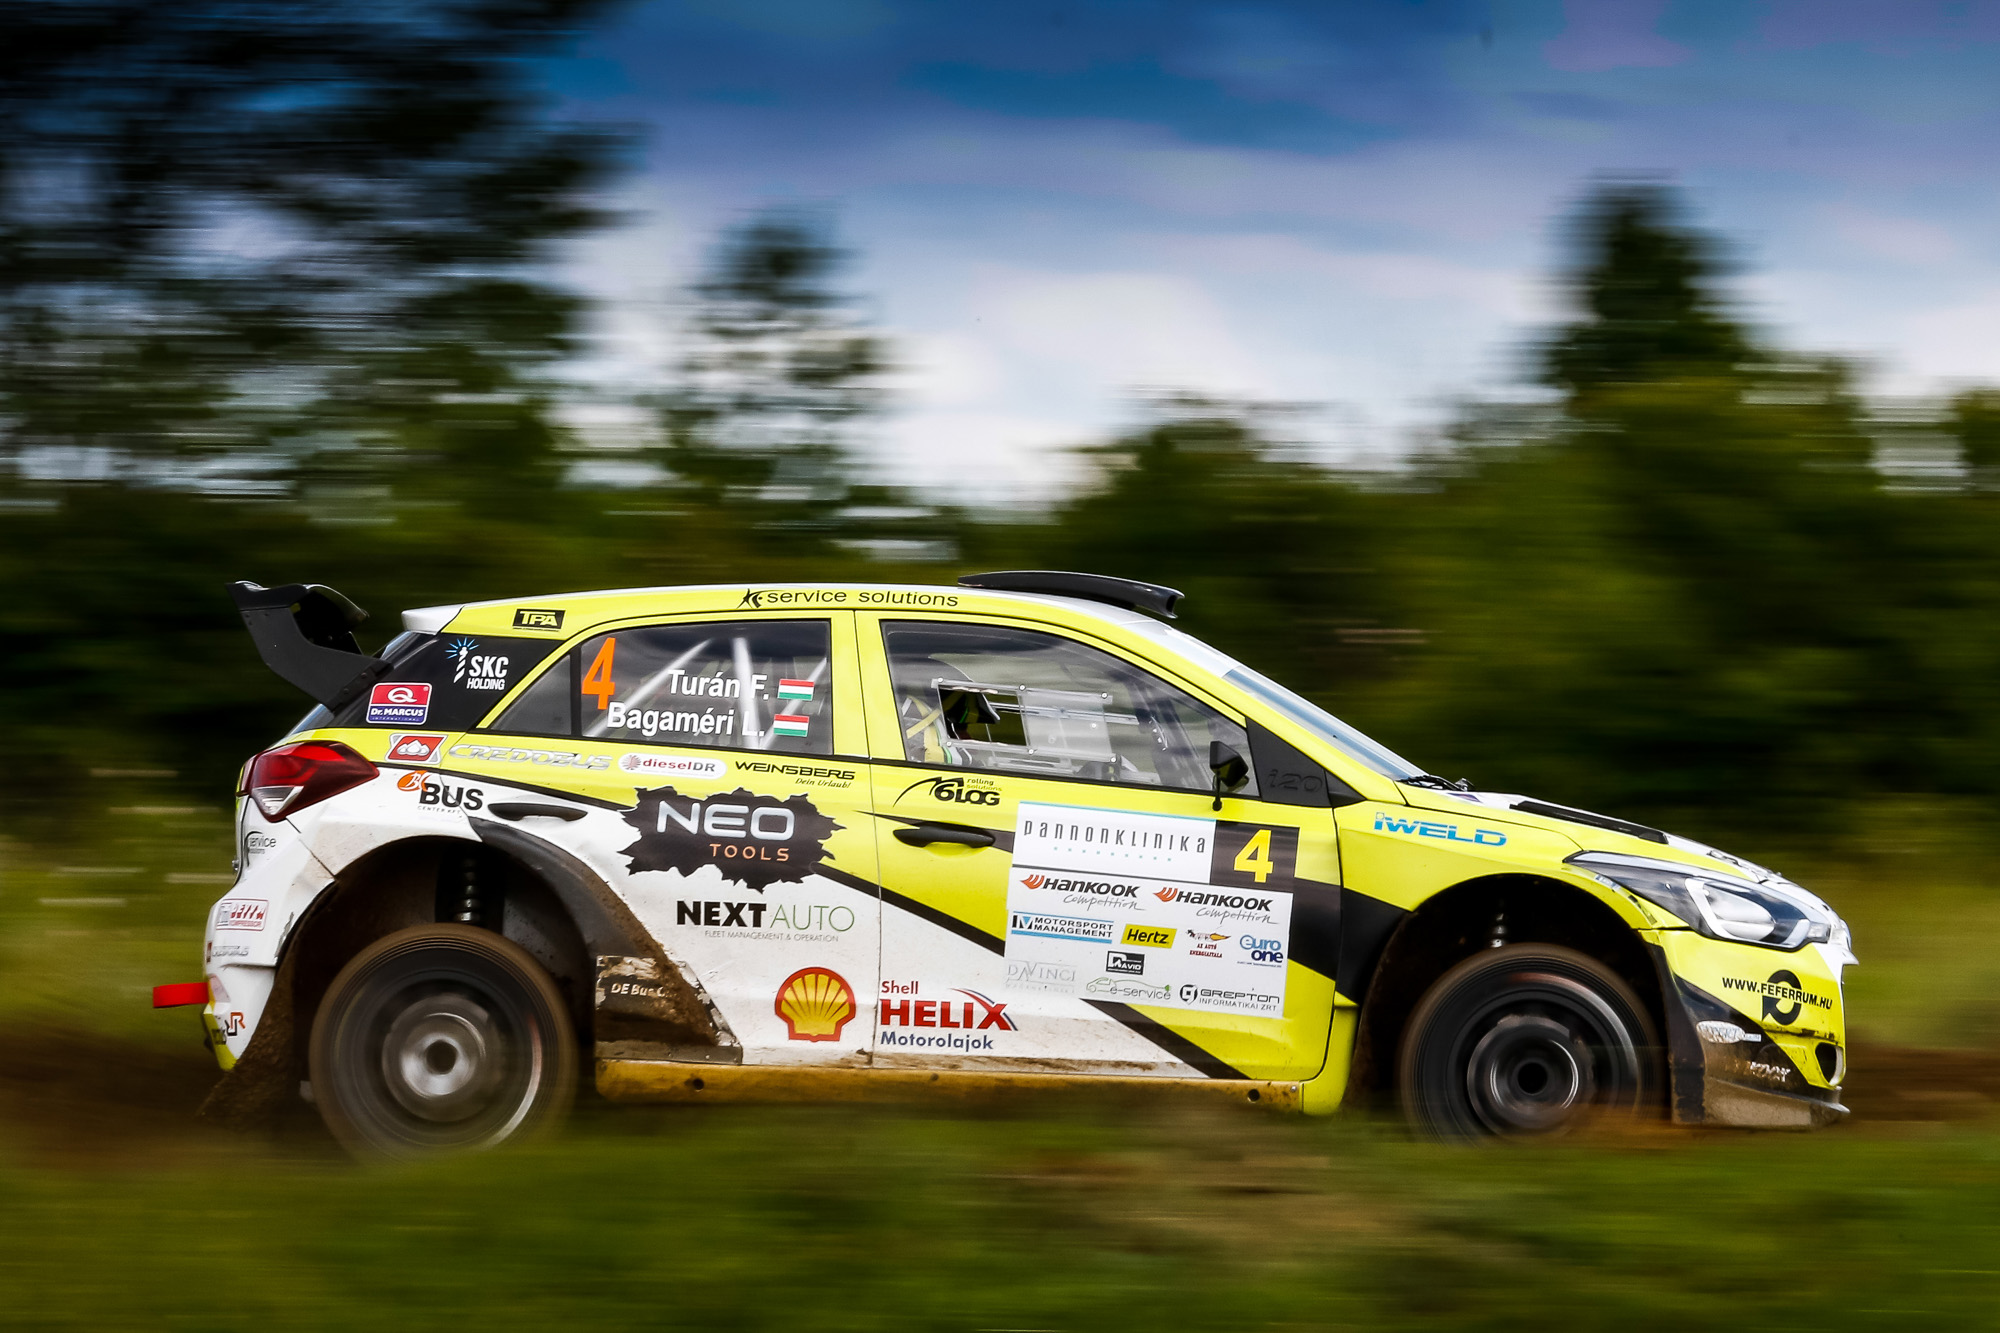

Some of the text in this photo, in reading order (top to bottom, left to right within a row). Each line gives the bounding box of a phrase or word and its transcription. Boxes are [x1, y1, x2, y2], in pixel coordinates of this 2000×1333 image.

[767, 589, 959, 607] service solutions
[519, 611, 558, 626] TPA
[469, 656, 509, 678] SKC
[582, 637, 616, 710] 4
[467, 678, 506, 690] HOLDING
[668, 669, 770, 700] Turán F.
[384, 708, 424, 717] MARCUS
[606, 701, 735, 737] Bagaméri
[449, 744, 613, 771] CREDOBUS
[642, 758, 716, 772] dieselDR
[735, 760, 857, 780] WEINSBERG
[795, 777, 852, 788] Dein Urlaub!
[967, 778, 994, 786] rolling
[419, 783, 484, 811] BUS
[656, 800, 795, 841] NEO
[709, 843, 790, 862] TOOLS
[1233, 829, 1274, 883] 4
[1033, 924, 1113, 938] MANAGEMENT
[1034, 916, 1114, 931] MOTORSPORT
[727, 931, 783, 941] MANAGEMENT
[794, 933, 839, 942] OPERATION
[1126, 928, 1169, 945] Hertz
[1240, 935, 1281, 951] euro
[1251, 950, 1283, 963] one
[881, 980, 919, 995] Shell
[1110, 986, 1171, 1000] e-service
[1722, 976, 1833, 1010] WWW.FEFERRUM.HU
[1200, 988, 1280, 1004] GREPTON
[1199, 998, 1277, 1012] INFORMATIKAI ZRT
[880, 999, 1013, 1032] HELIX
[880, 1031, 994, 1053] Motorolajok
